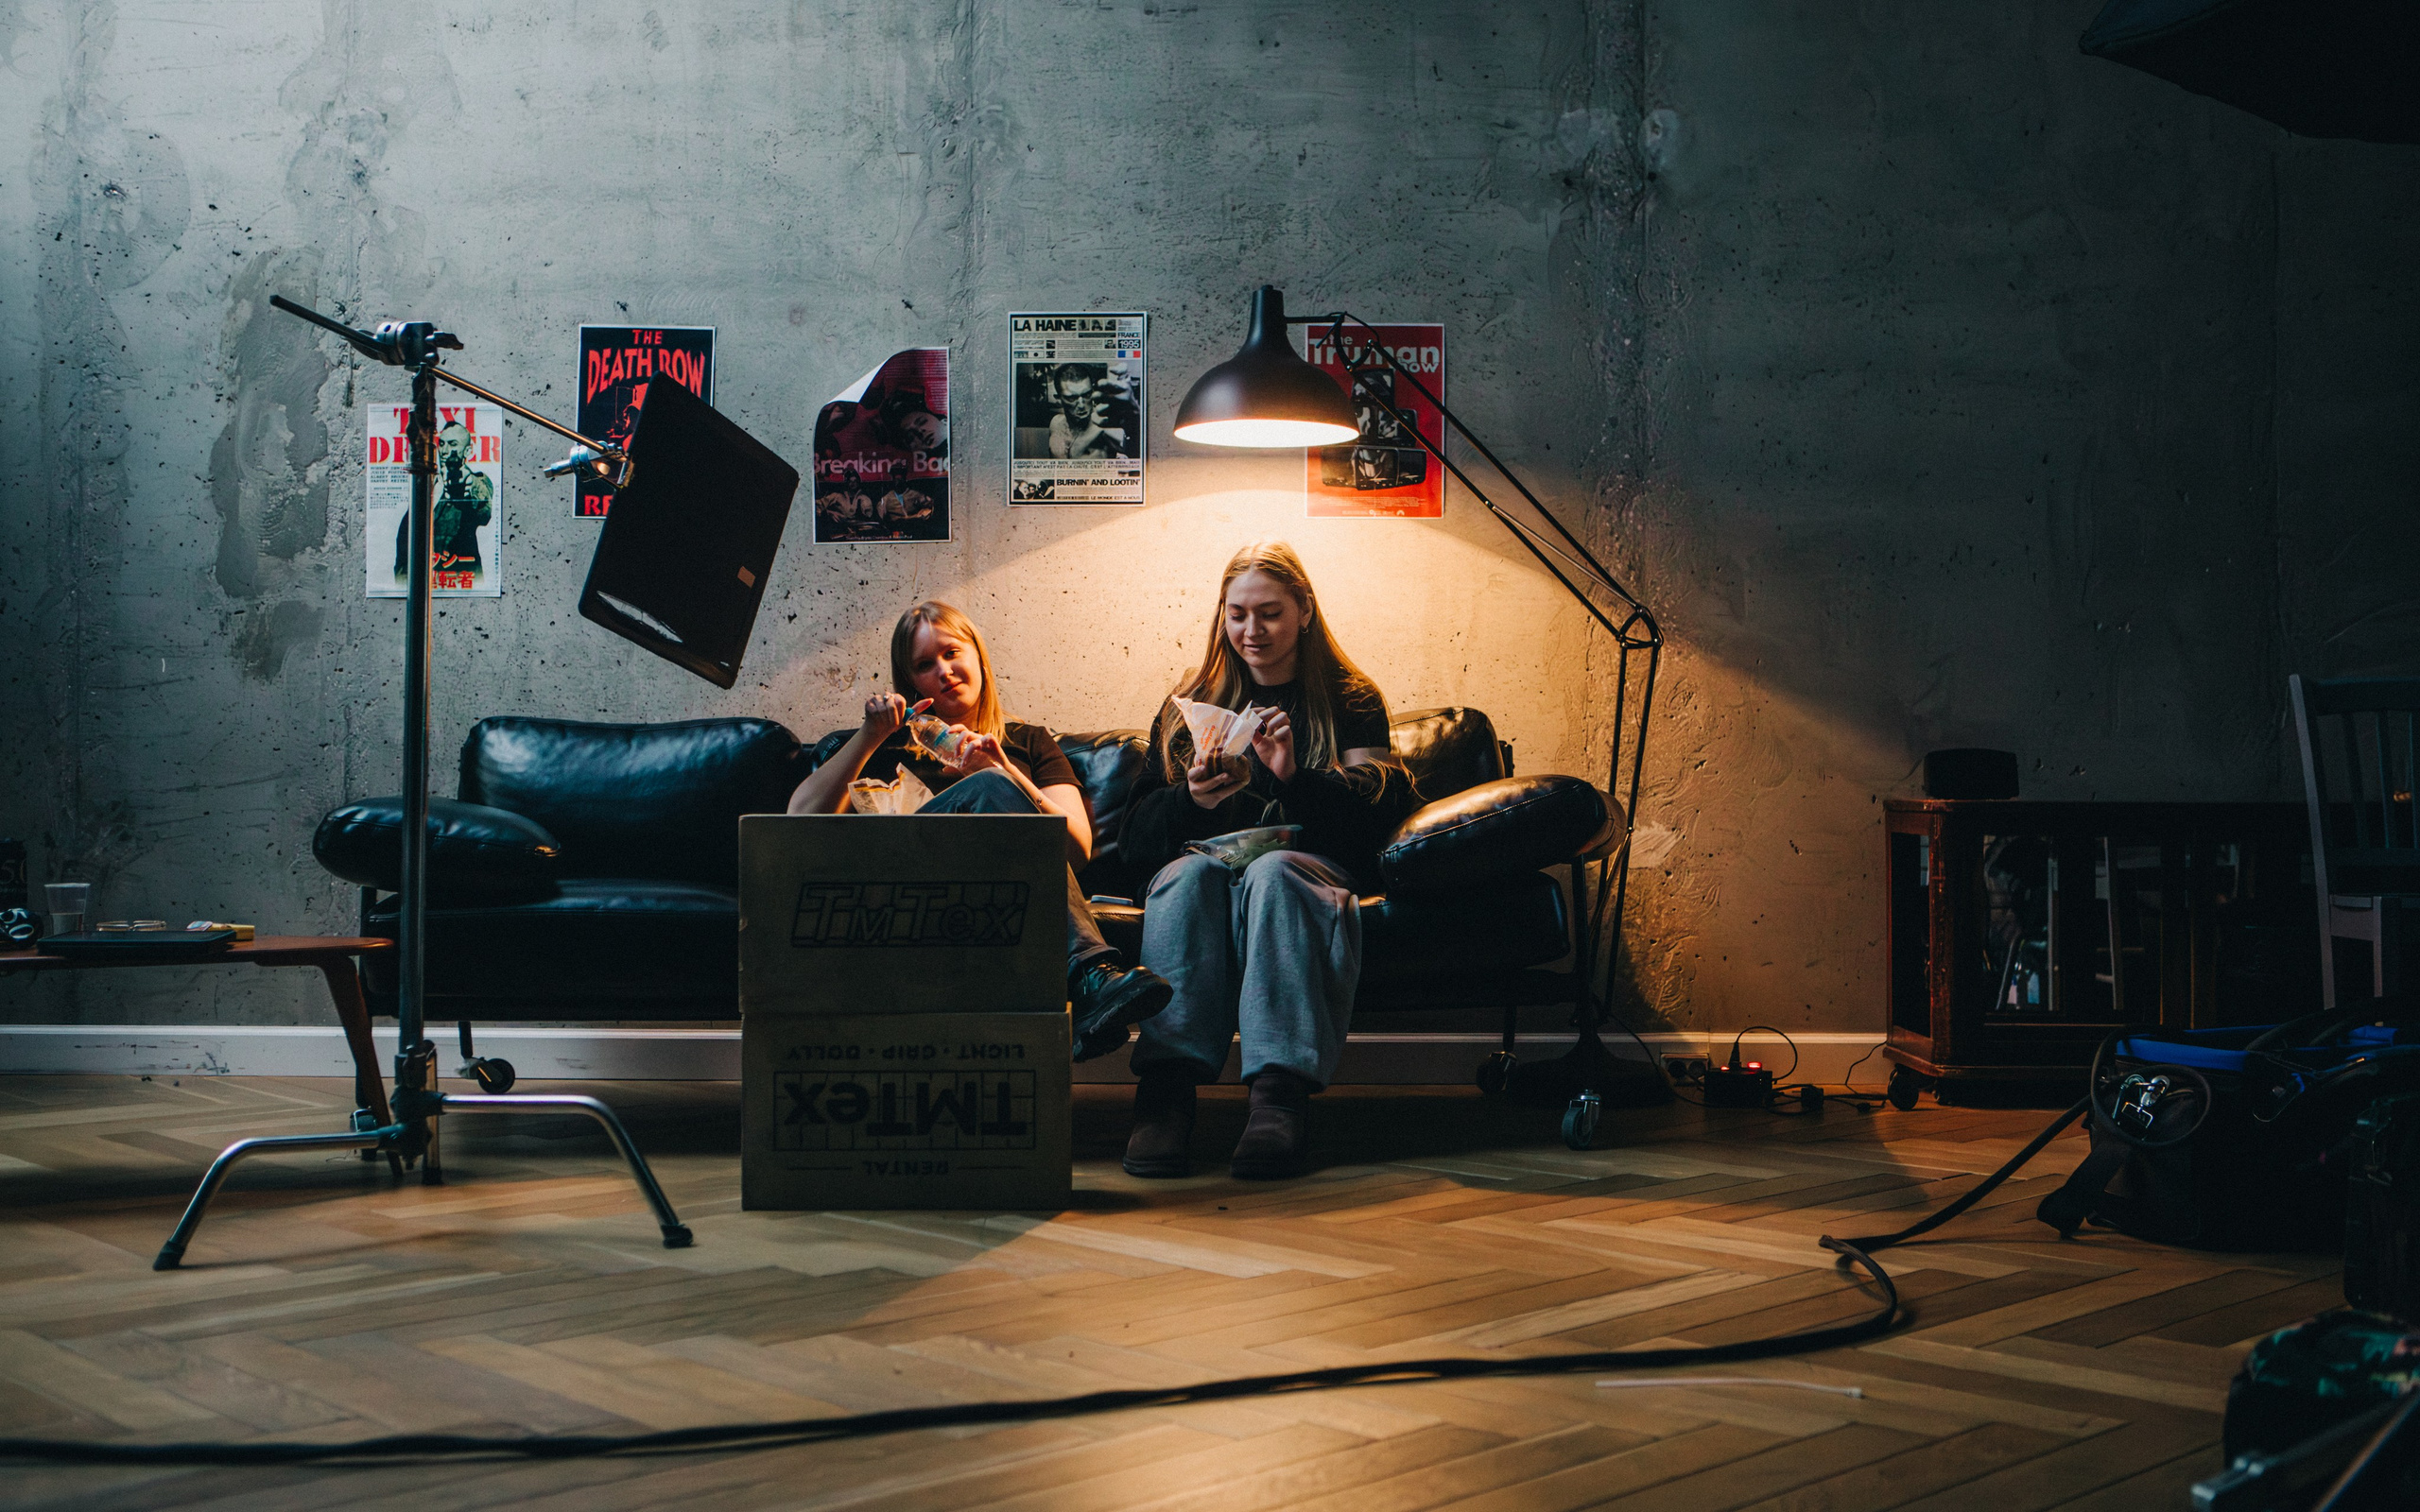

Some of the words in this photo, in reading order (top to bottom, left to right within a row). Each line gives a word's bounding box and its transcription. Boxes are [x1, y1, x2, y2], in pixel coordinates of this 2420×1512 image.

[1014, 319, 1031, 331] LA
[1036, 319, 1077, 331] HAINE
[632, 329, 663, 345] THE
[1119, 339, 1140, 349] 1995
[587, 348, 652, 405] DEATH
[658, 349, 705, 398] ROW
[786, 1044, 861, 1060] DOLLY
[882, 1044, 937, 1060] GRIP
[958, 1044, 1025, 1060] LIGHT
[784, 1081, 1028, 1136] TMTex
[862, 1160, 949, 1177] RENTAL
